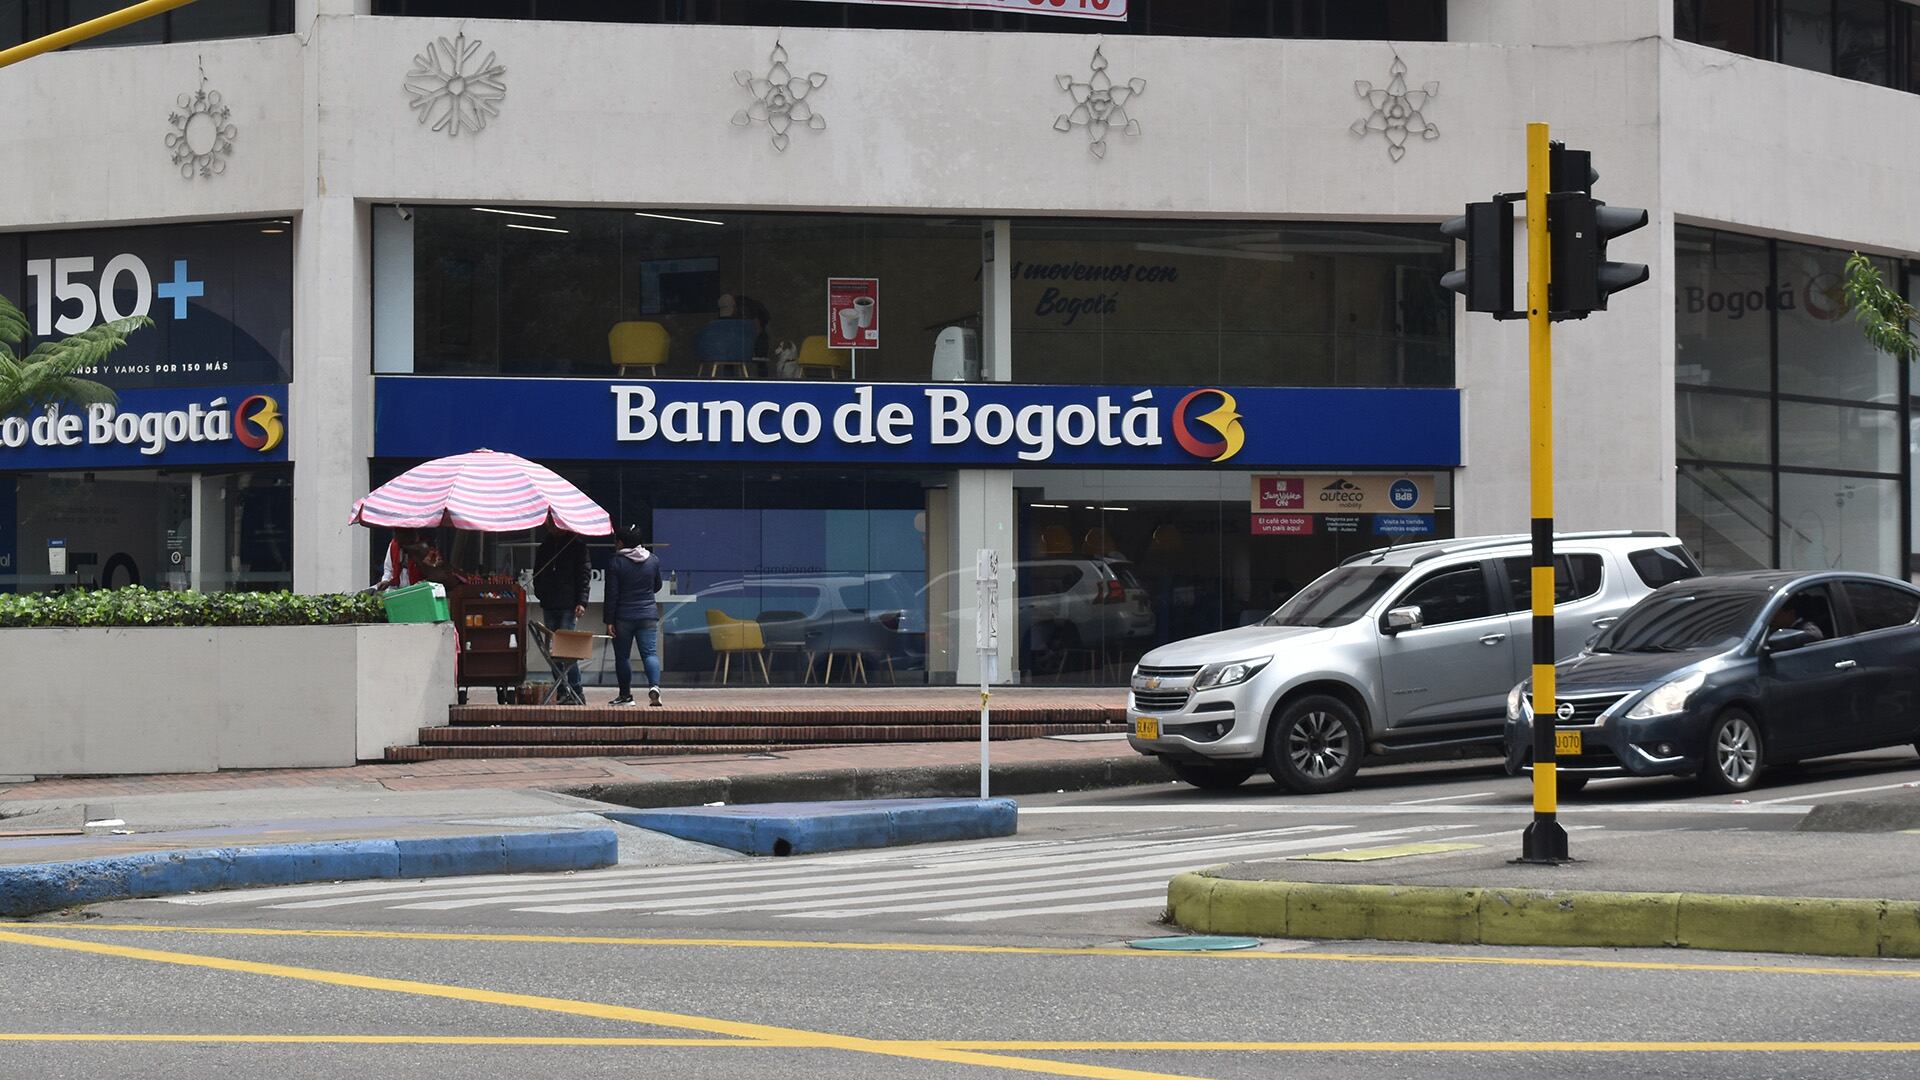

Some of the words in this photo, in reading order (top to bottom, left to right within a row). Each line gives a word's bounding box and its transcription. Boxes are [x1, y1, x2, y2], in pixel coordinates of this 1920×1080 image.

[1023, 261, 1130, 282] movemos
[1135, 264, 1178, 282] con
[1034, 288, 1119, 326] Bogotá
[103, 366, 109, 374] Y
[114, 365, 150, 374] VAMOS
[155, 364, 177, 373] POR
[182, 363, 200, 372] 150
[205, 360, 228, 371] MÁS
[0, 416, 29, 448] o
[31, 402, 84, 447] de
[87, 397, 232, 455] Bogotá
[610, 385, 823, 444] Banco
[832, 386, 915, 445] de
[924, 388, 1163, 462] Bogotá
[1320, 491, 1364, 501] auteco
[1395, 492, 1412, 501] BdB
